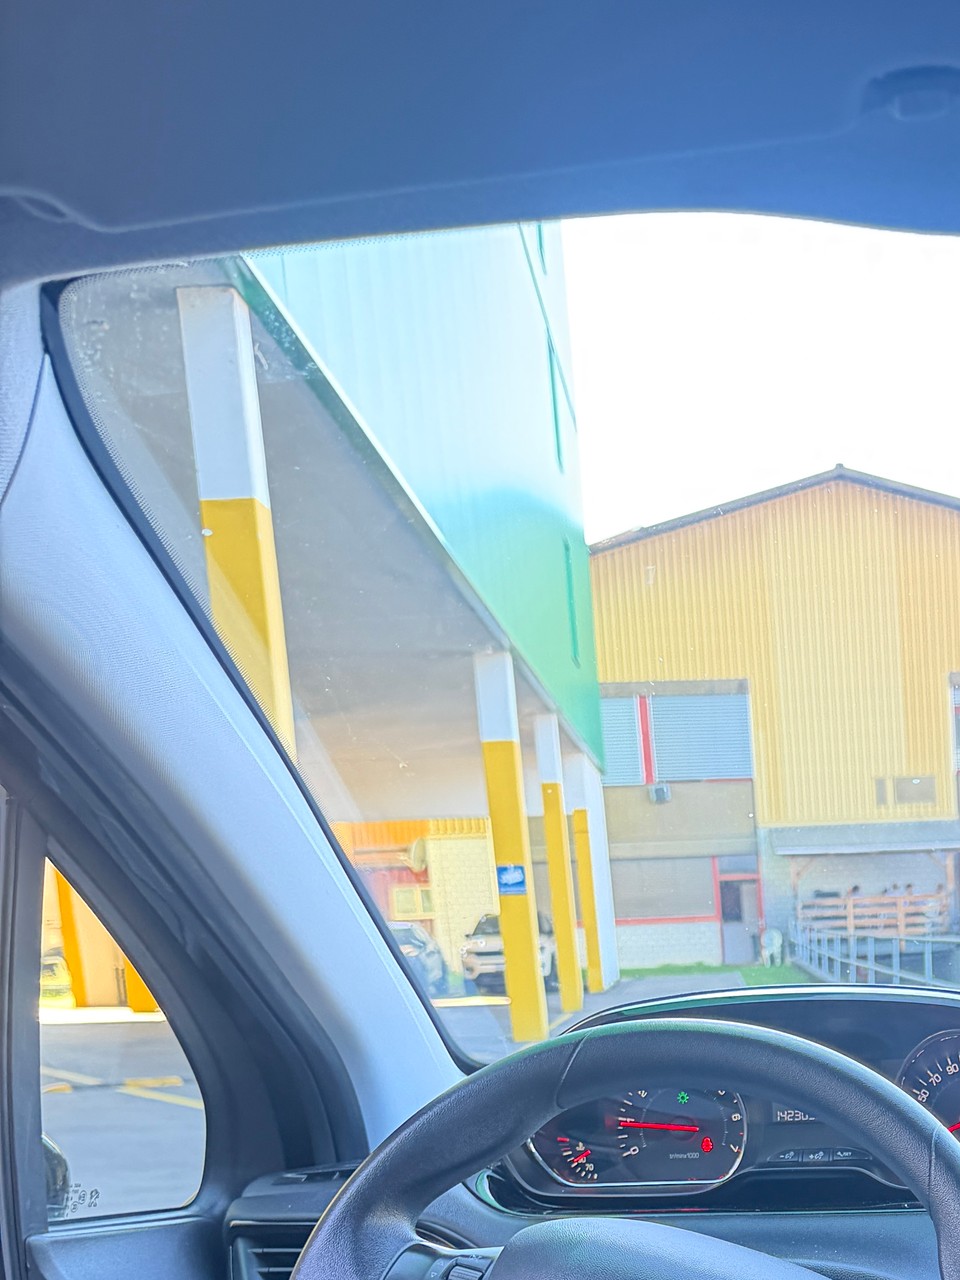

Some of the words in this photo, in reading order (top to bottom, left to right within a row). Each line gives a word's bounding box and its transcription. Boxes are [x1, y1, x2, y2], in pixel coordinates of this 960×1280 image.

[946, 1063, 959, 1075] 90
[929, 1073, 942, 1086] 70
[918, 1089, 930, 1103] 50
